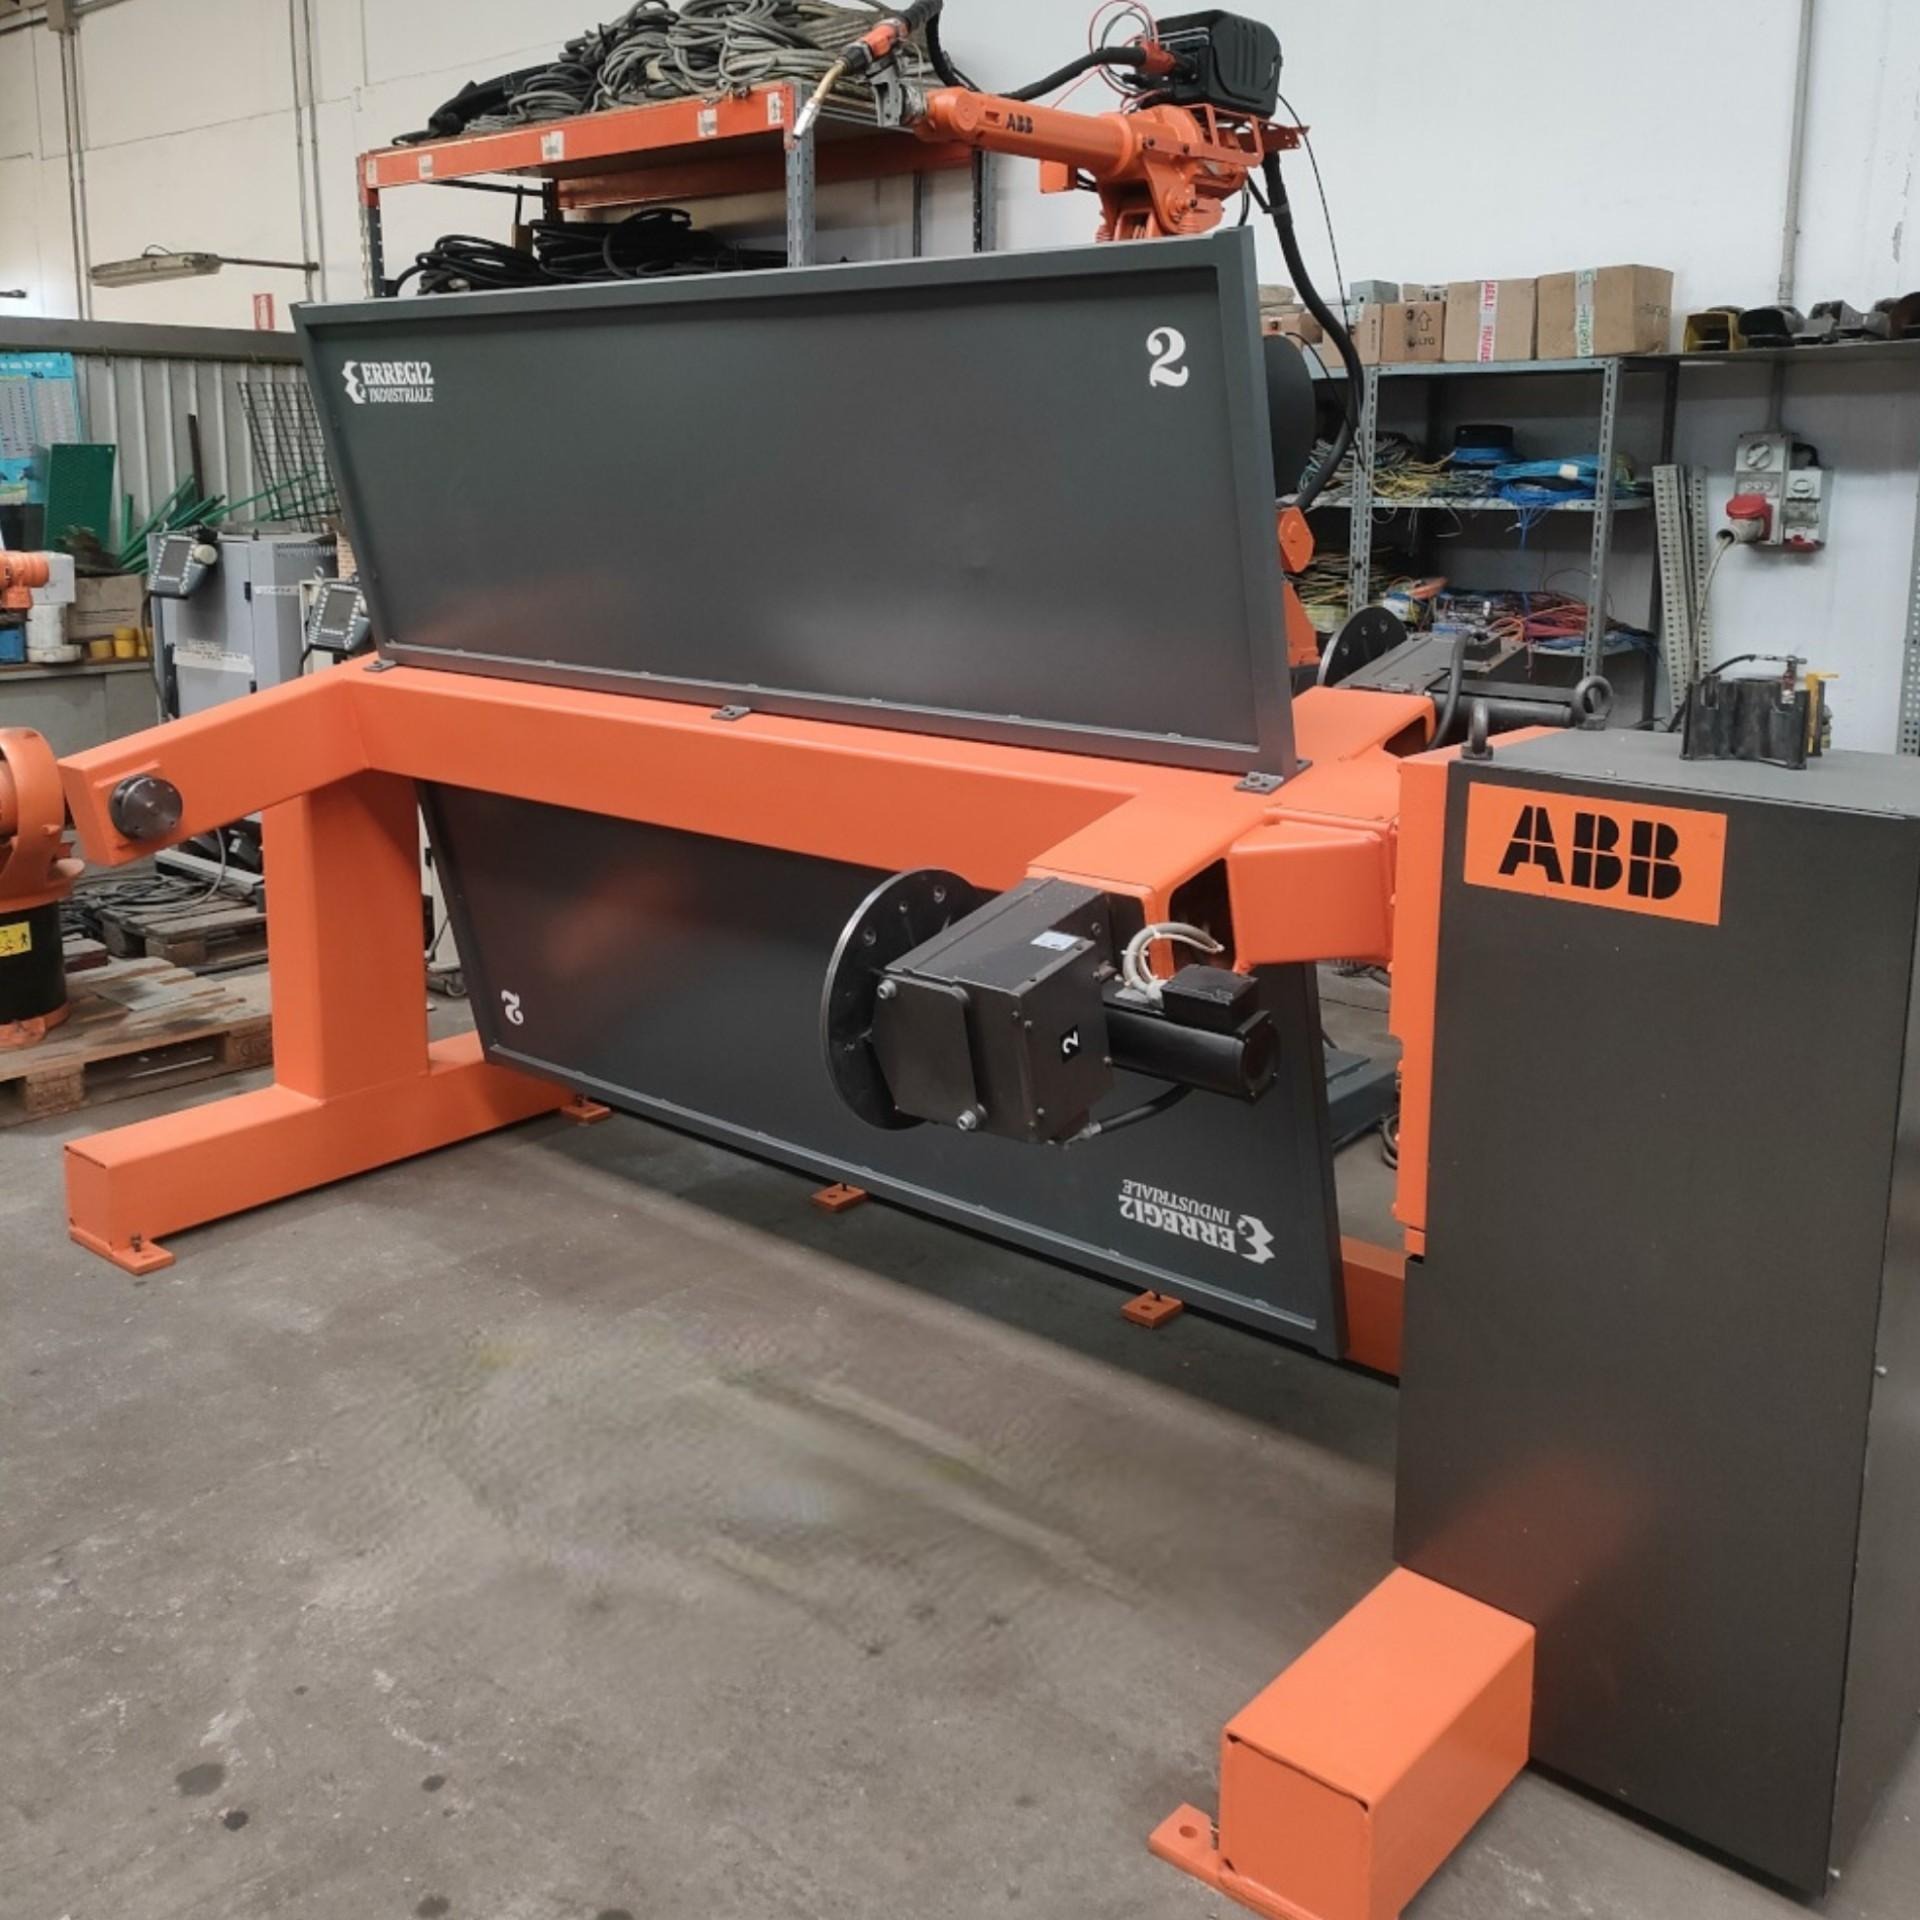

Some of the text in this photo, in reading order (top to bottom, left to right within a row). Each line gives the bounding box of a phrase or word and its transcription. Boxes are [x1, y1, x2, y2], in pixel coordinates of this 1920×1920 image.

[1006, 112, 1034, 134] ABB
[360, 361, 435, 386] ERREGI2
[1146, 326, 1189, 387] 2
[367, 387, 434, 403] INDUSTRIALE
[1498, 804, 1683, 900] ABB
[501, 989, 524, 1026] 2
[1062, 1030, 1079, 1054] 2
[1122, 1178, 1231, 1226] INDUSTRIALE
[1118, 1194, 1238, 1254] ERREGI2
